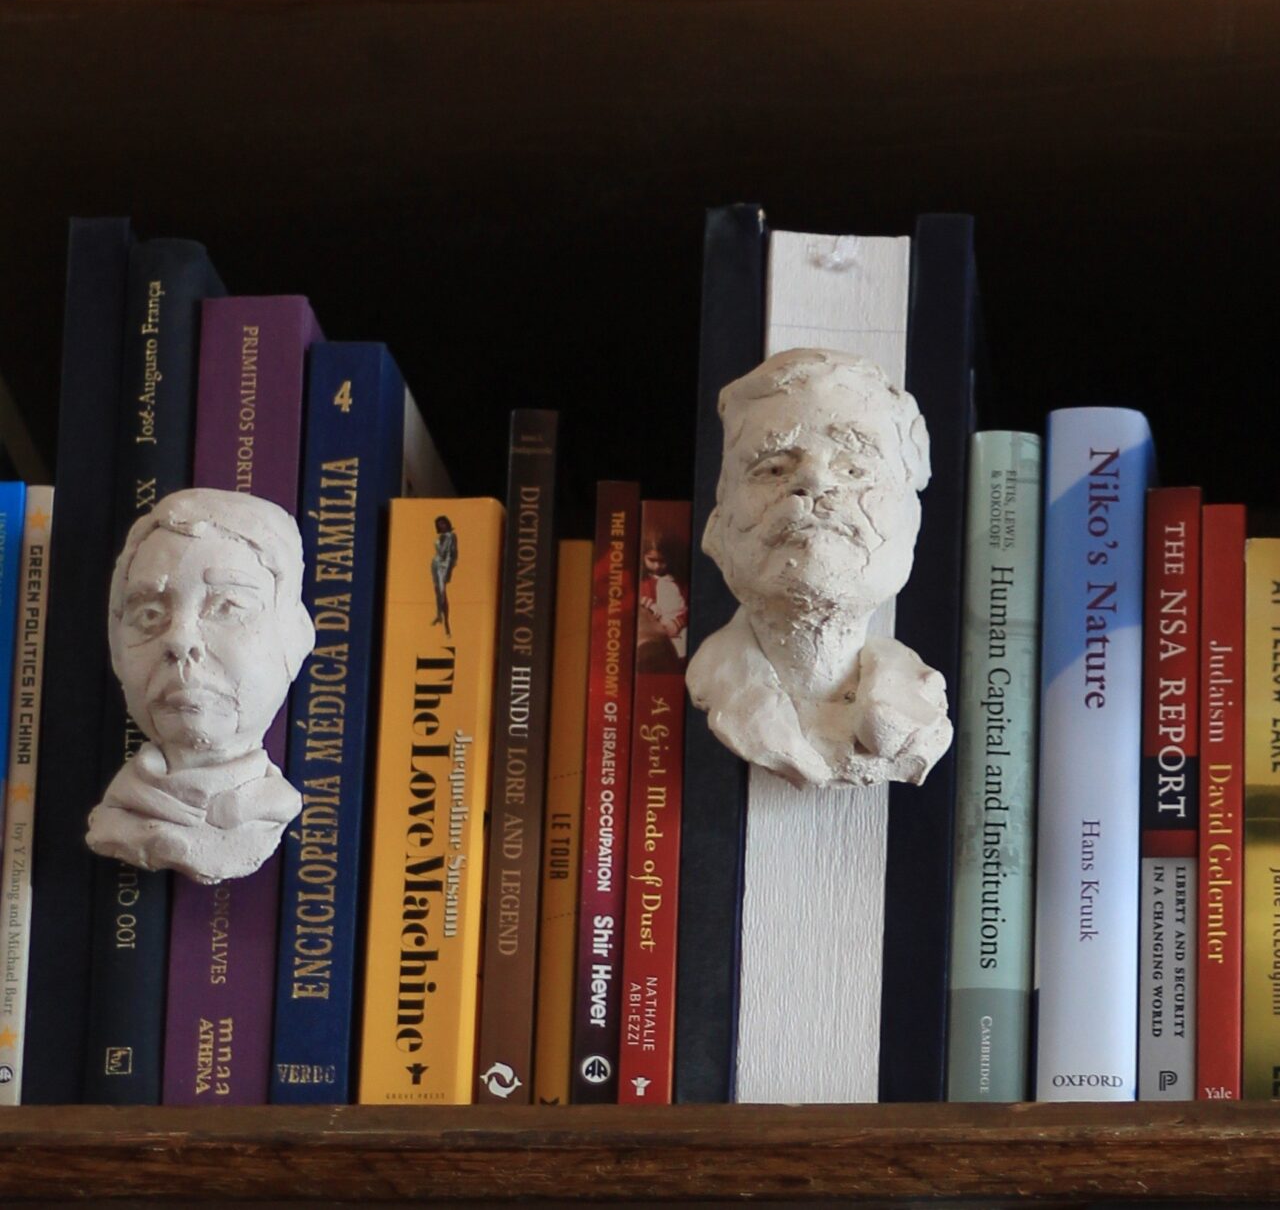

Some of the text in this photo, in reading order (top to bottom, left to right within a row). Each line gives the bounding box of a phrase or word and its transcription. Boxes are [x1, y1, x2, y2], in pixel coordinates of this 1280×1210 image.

[137, 280, 167, 445] José-Augusto França
[237, 325, 260, 431] PRIMITIVOS
[333, 380, 352, 413] 4
[1084, 448, 1120, 709] Niko's Nature
[17, 544, 44, 765] GREEN POLITICS IN CHINA
[498, 486, 541, 957] DICTIONARY OF HINDU LORE AND LEGEND
[1156, 522, 1188, 817] THE NSA REPORT
[290, 456, 360, 1000] ENCICLOPÉDIA MÉDICA DA FAMÍLIA
[979, 566, 1015, 969] Human Capital and Institutions
[394, 646, 457, 1053] The Love Machine
[549, 813, 572, 880] LE TOUR
[1206, 640, 1235, 963] Judaism David Gelernter
[1079, 819, 1101, 941] Hans Kruuk
[1173, 865, 1188, 1038] LIBERTY AND SECURITY
[590, 915, 615, 1028] Shir Hever
[195, 1018, 216, 1095] ATHENA
[216, 1017, 233, 1096] mnaa
[979, 1015, 994, 1094] CAMBRIDGE
[1052, 1075, 1124, 1088] OXFORD
[1203, 1087, 1233, 1100] Yale
